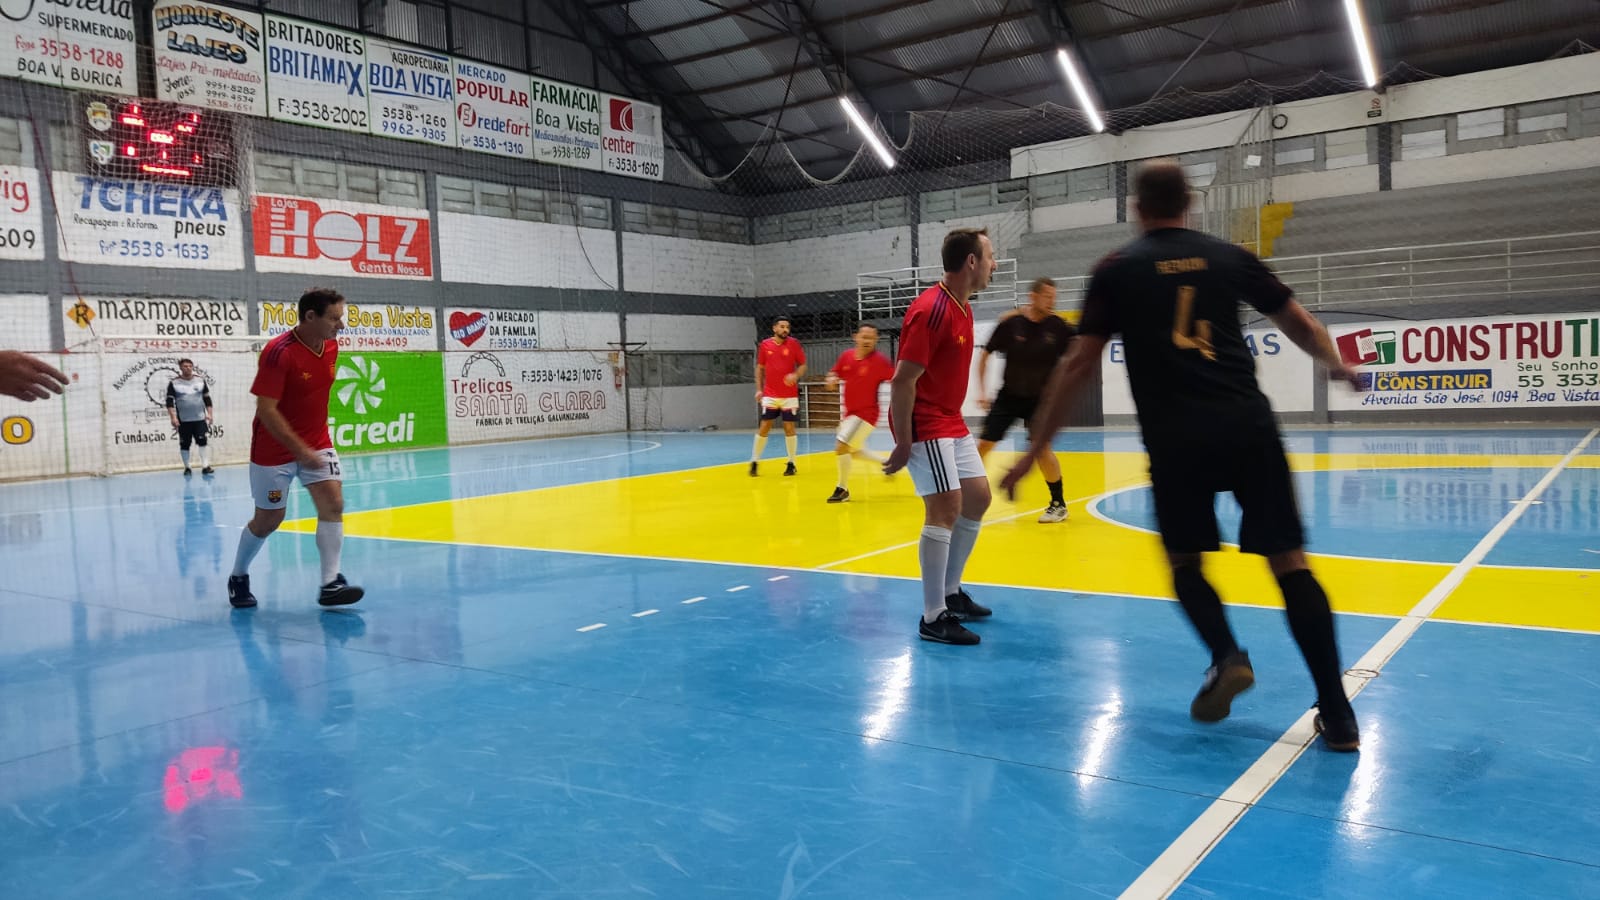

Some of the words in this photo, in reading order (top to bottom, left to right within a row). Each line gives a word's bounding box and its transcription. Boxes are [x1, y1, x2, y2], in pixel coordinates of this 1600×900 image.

[38, 12, 134, 41] SUPERMERCADO
[155, 4, 260, 52] NOROESTE
[267, 19, 363, 56] BRITADORES
[39, 37, 124, 69] 3538-1288
[167, 30, 247, 64] LAJES
[18, 57, 46, 76] BOA
[51, 63, 64, 79] V.
[71, 66, 123, 88] BURICÁ
[268, 45, 365, 98] BRITAMAX
[369, 62, 407, 91] BOA
[411, 70, 453, 101] VISTA
[457, 63, 506, 84] MERCADO
[456, 78, 529, 109] POPULAR
[532, 81, 600, 114] FARMÁCIA
[382, 106, 447, 128] 3538-1260
[535, 108, 561, 129] Boa
[566, 113, 600, 137] Vista
[382, 120, 446, 142] 9962-9305
[473, 135, 524, 155] 3538-1310
[75, 175, 229, 221] TCHEKA
[173, 219, 227, 239] pneus
[269, 209, 419, 264] HOLZ
[119, 238, 209, 260] 3538-1633
[358, 261, 394, 274] Gente
[397, 264, 424, 276] Nossa
[347, 303, 383, 328] Boa
[387, 306, 433, 330] Vista
[489, 311, 495, 322] O
[496, 311, 535, 323] MERCADO
[1171, 285, 1218, 362] 4
[357, 336, 408, 347] 9146-4109
[489, 326, 500, 336] DA
[502, 325, 537, 337] FAMILIA
[1402, 318, 1599, 364] CONSTRUTI
[1110, 341, 1125, 363] E
[1516, 361, 1542, 371] Seu
[1551, 360, 1599, 371] Sonho
[451, 378, 513, 395] Treliças
[1376, 373, 1490, 391] CONSTRUIR
[1518, 374, 1544, 388] 55
[1555, 373, 1600, 387] 353
[455, 392, 528, 418] SANTA
[538, 389, 607, 413] CLARA
[1361, 392, 1417, 406] Avenida
[1423, 391, 1448, 404] São
[1491, 390, 1519, 403] 1094
[1526, 389, 1556, 403] Boa
[1561, 388, 1600, 402] Vista
[328, 412, 414, 447] icredi
[505, 416, 513, 425] DE
[115, 430, 166, 445] Fundação
[328, 461, 341, 476] 15
